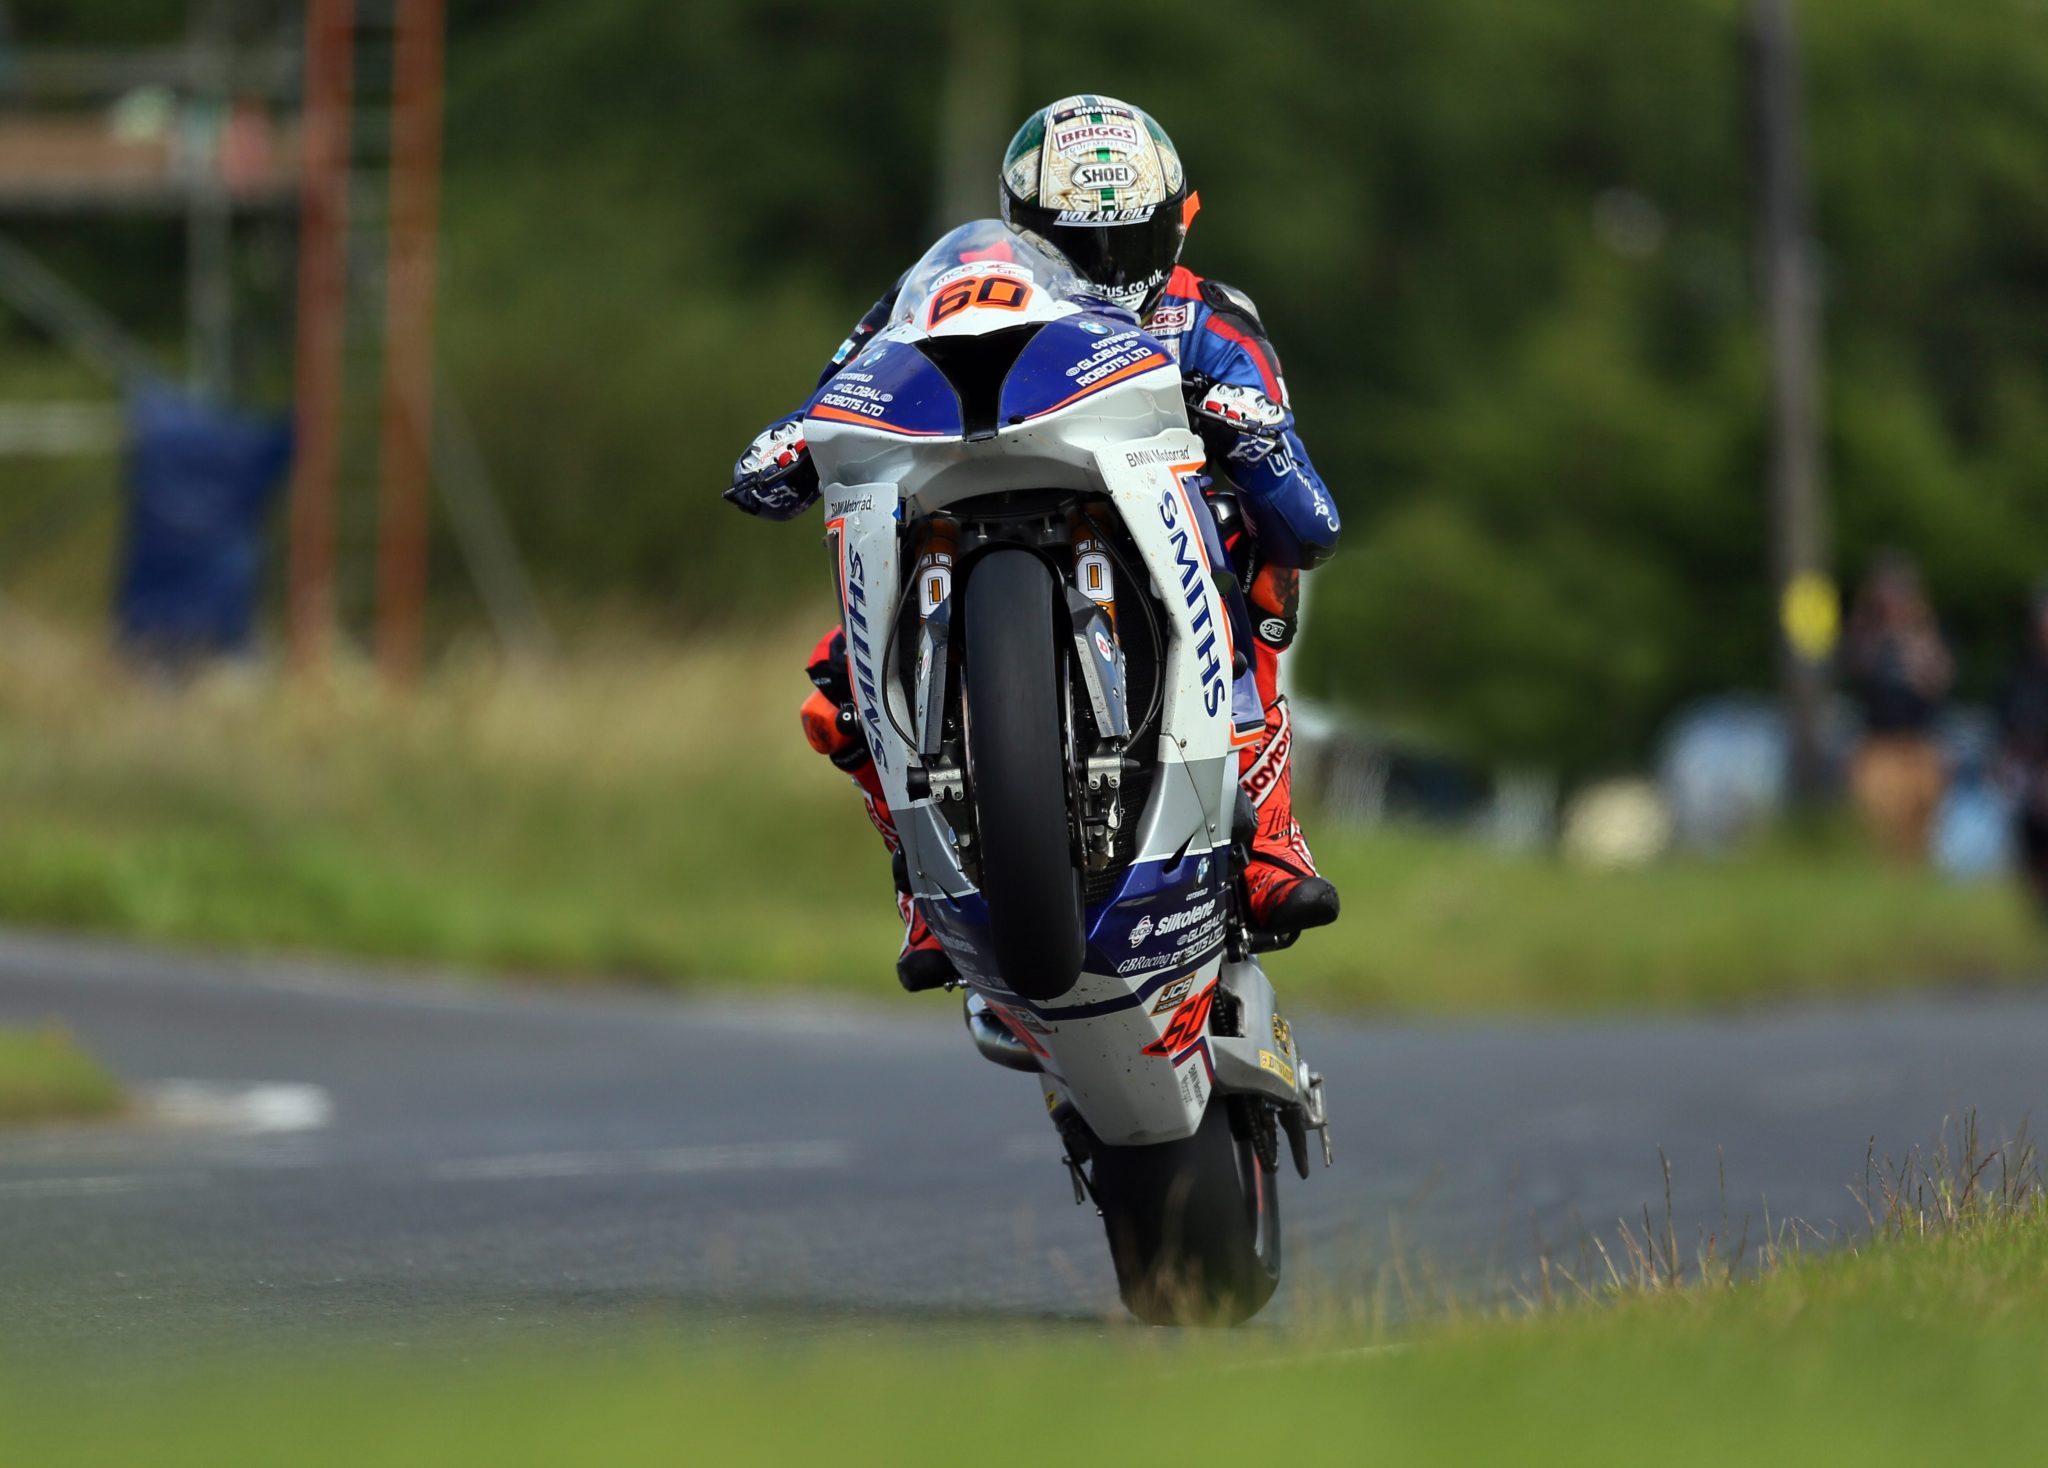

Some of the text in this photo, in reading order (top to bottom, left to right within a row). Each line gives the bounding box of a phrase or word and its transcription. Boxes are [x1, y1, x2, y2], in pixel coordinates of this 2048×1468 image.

[1061, 127, 1132, 144] BRIGGS
[1081, 167, 1129, 184] SHOEI
[1056, 210, 1119, 222] NOLAN
[930, 277, 1029, 326] 60
[1091, 330, 1140, 350] COTSWOLD
[1076, 356, 1130, 387] ROBOTS
[1126, 347, 1152, 362] LTD
[1077, 344, 1129, 371] GLOBAL
[836, 373, 874, 383] COTSWOLD
[841, 383, 882, 401] GLOBAL
[820, 393, 885, 417] ROBOTS LTD
[1125, 444, 1190, 468] BMW Motorrad
[1157, 488, 1226, 719] SMITHS
[848, 542, 890, 775] SMITHS
[1155, 899, 1216, 937] Silkolene
[1187, 914, 1220, 943] GLOBAL
[1160, 977, 1193, 1002] JCB
